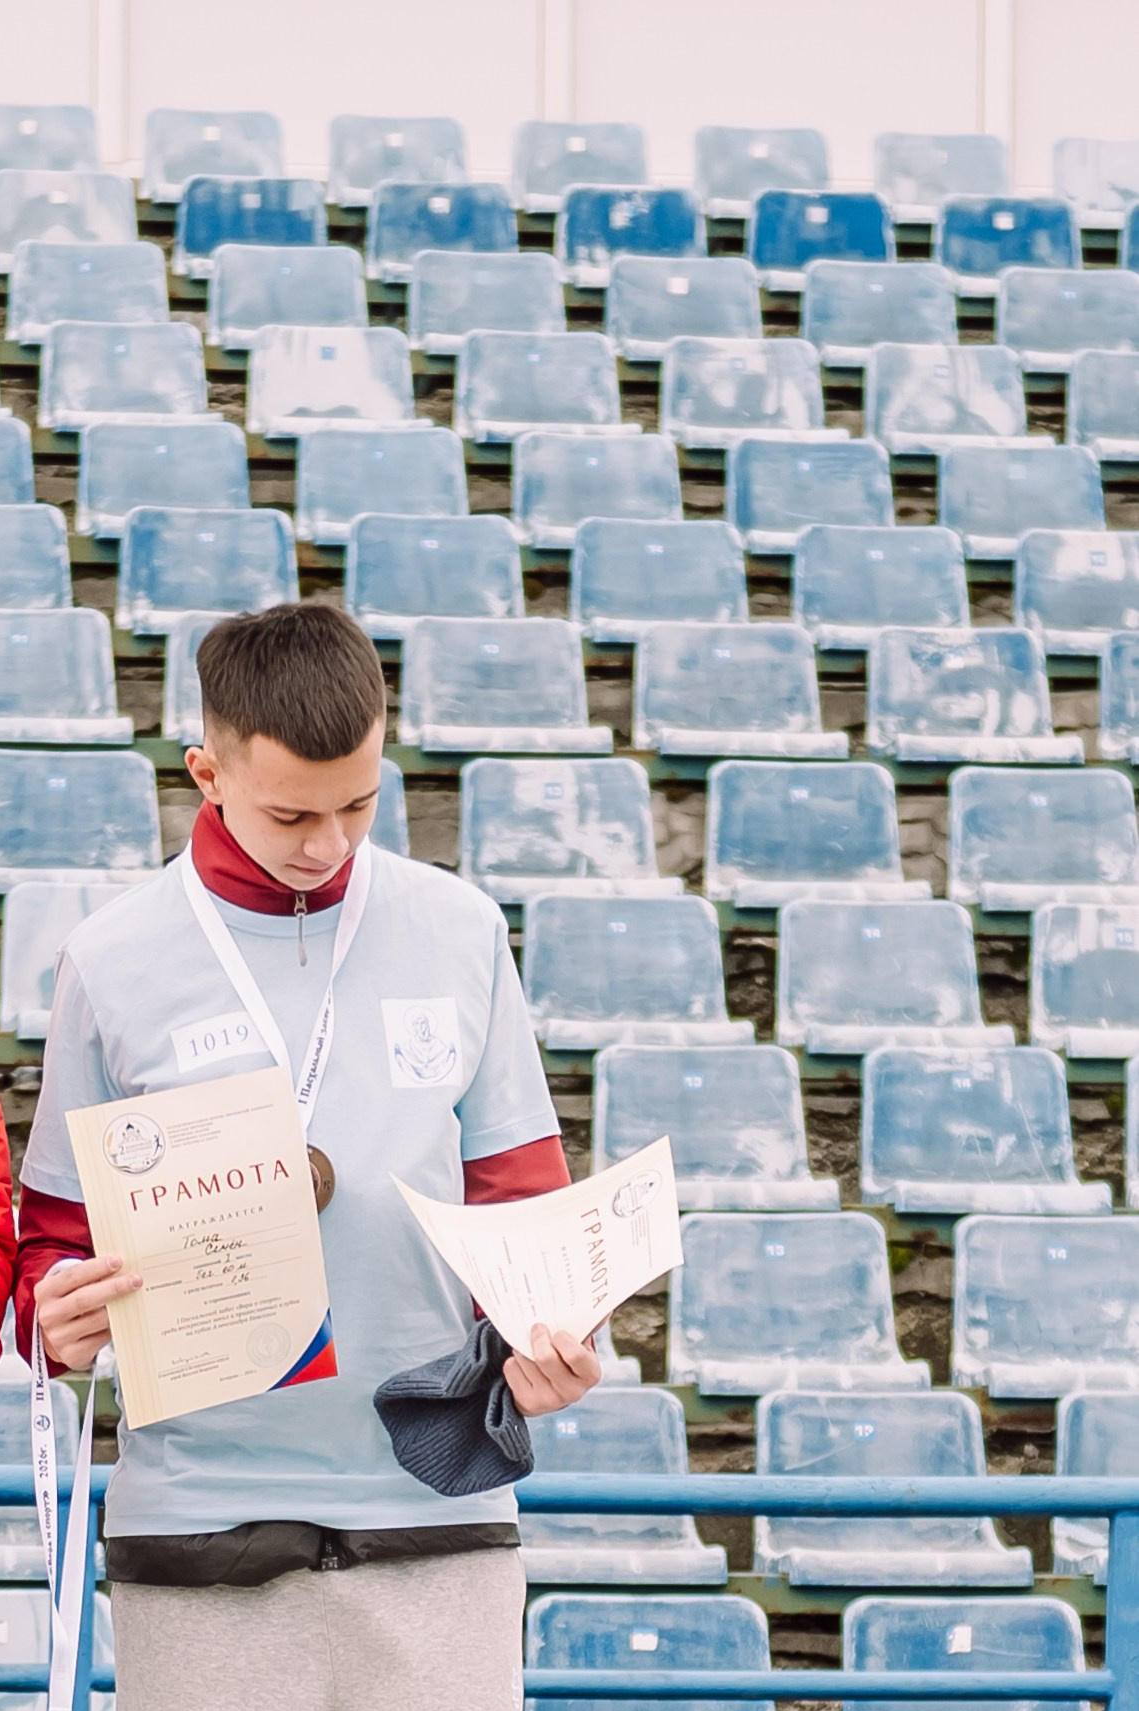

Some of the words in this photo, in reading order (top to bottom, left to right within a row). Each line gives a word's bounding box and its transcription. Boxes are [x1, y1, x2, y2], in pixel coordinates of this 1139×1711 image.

[189, 1024, 249, 1057] 1019
[130, 1158, 290, 1211] ГРАМОТА
[168, 1206, 264, 1232] НАГРАЖДАЕТСЯ
[580, 1207, 609, 1309] ГРАМОТА
[557, 1421, 577, 1435] 12
